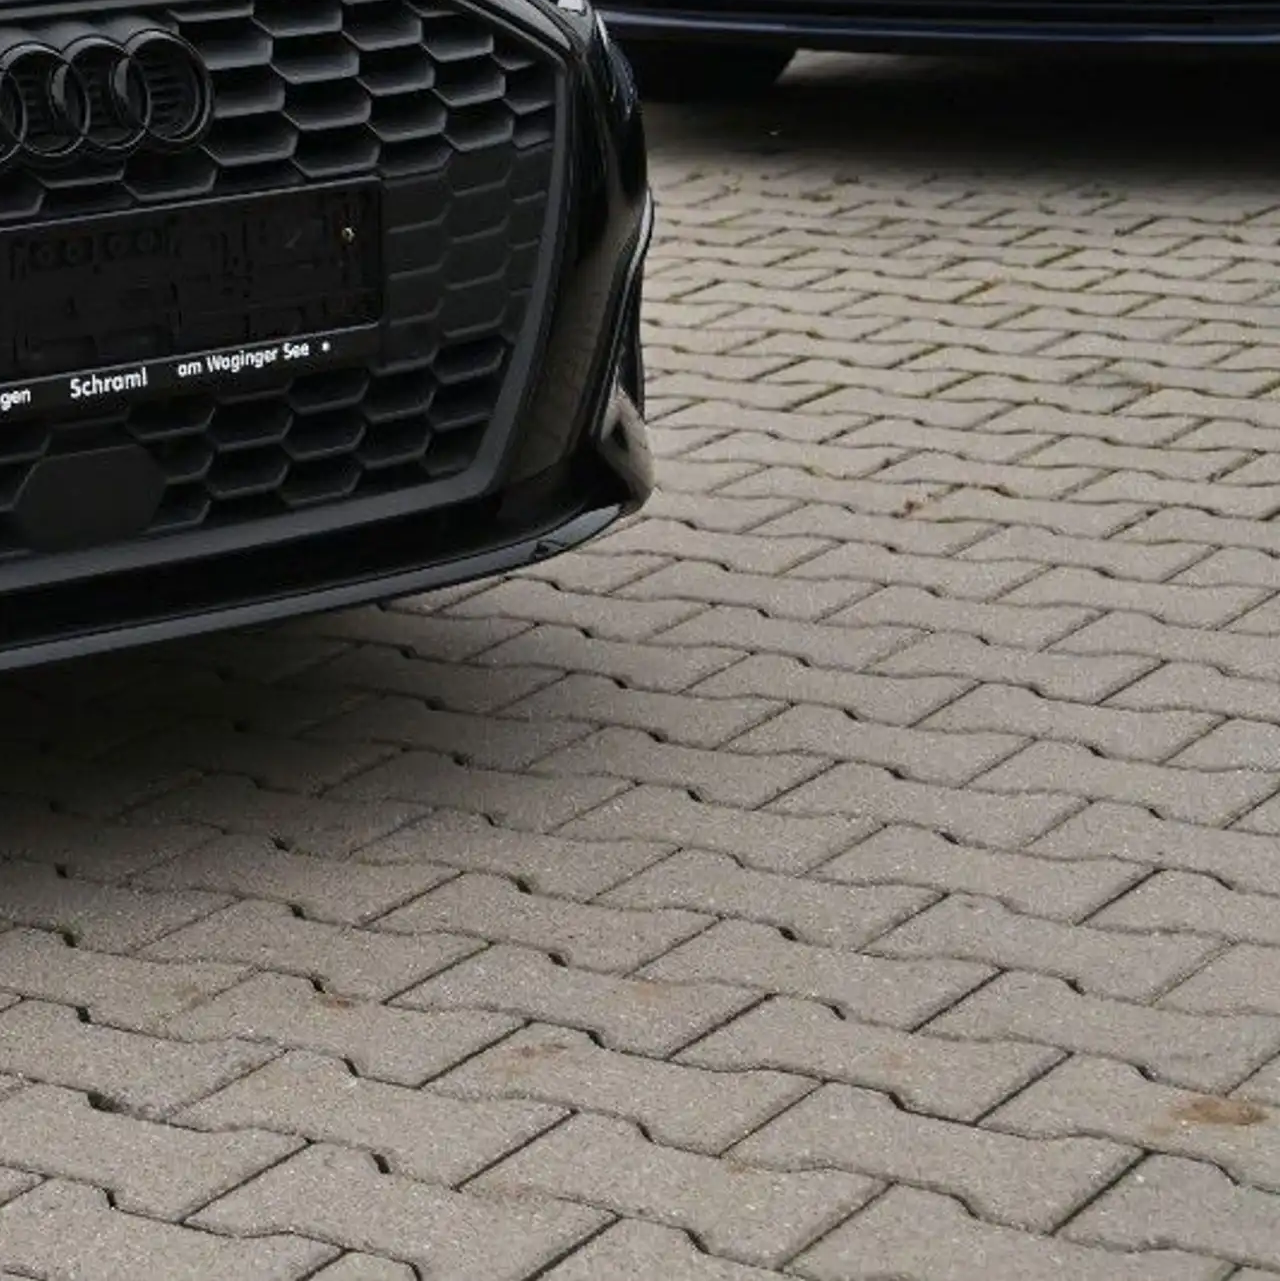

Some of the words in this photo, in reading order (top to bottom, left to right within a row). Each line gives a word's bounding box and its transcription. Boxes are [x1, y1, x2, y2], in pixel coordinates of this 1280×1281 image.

[70, 367, 148, 399] Schraml
[177, 361, 203, 378] am
[206, 348, 279, 374] Waginger
[282, 342, 310, 361] See
